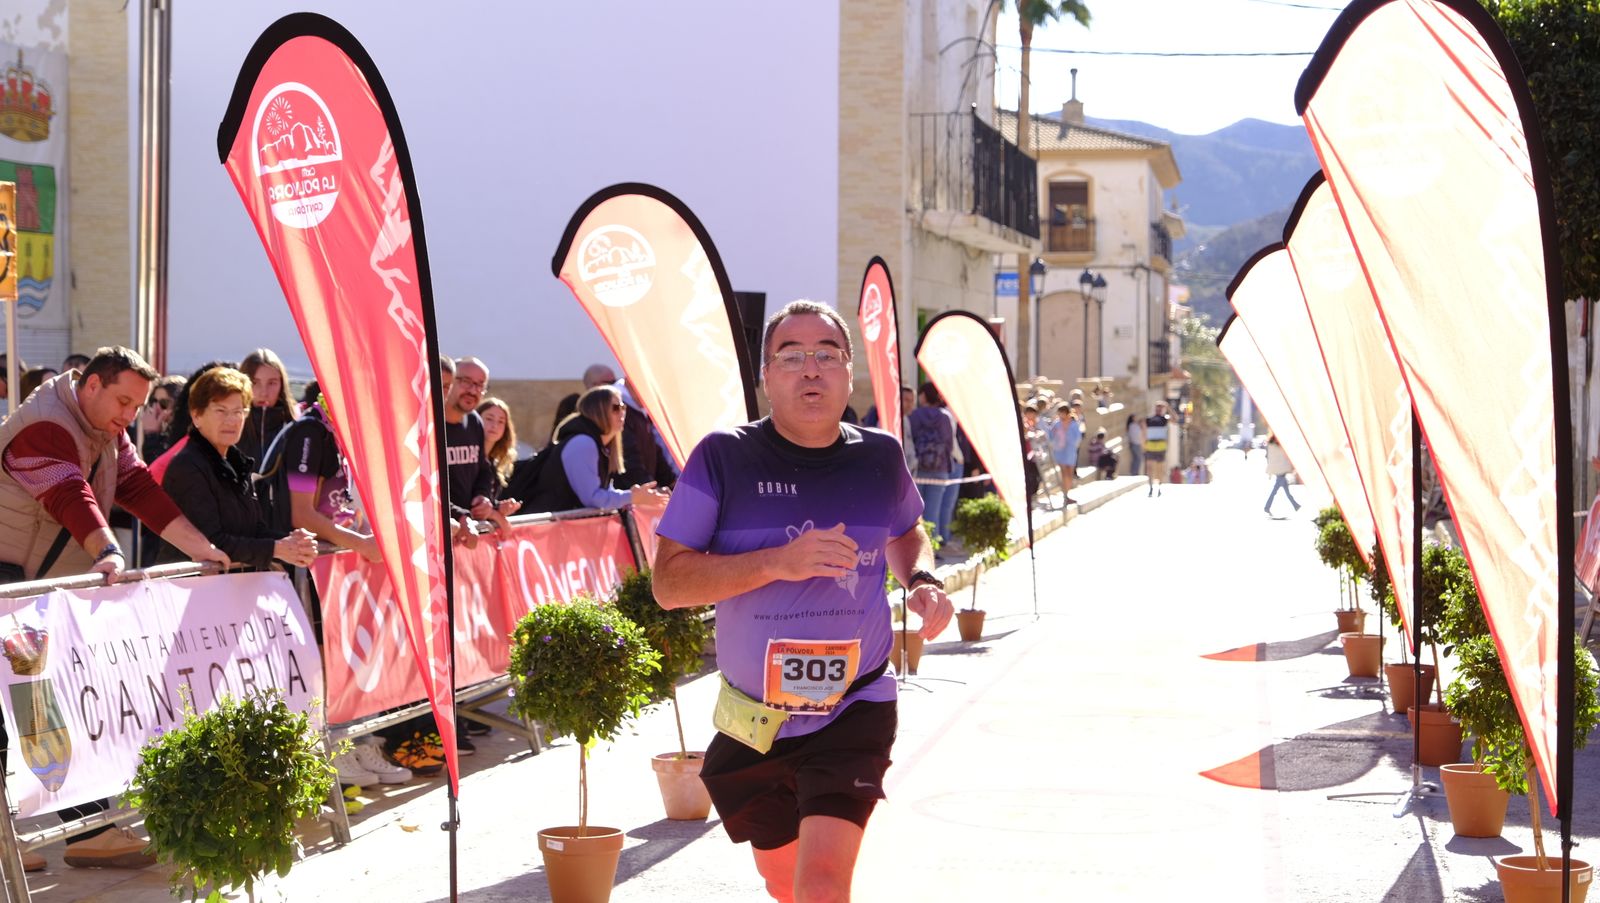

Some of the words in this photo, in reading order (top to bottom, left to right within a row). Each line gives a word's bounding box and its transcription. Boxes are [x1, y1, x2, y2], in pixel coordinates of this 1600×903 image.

[758, 481, 798, 494] GOBIK
[71, 620, 256, 673] AYUNTAMIENTO
[264, 615, 293, 640] DE
[783, 658, 846, 682] 303
[79, 649, 308, 742] CANTORIA
